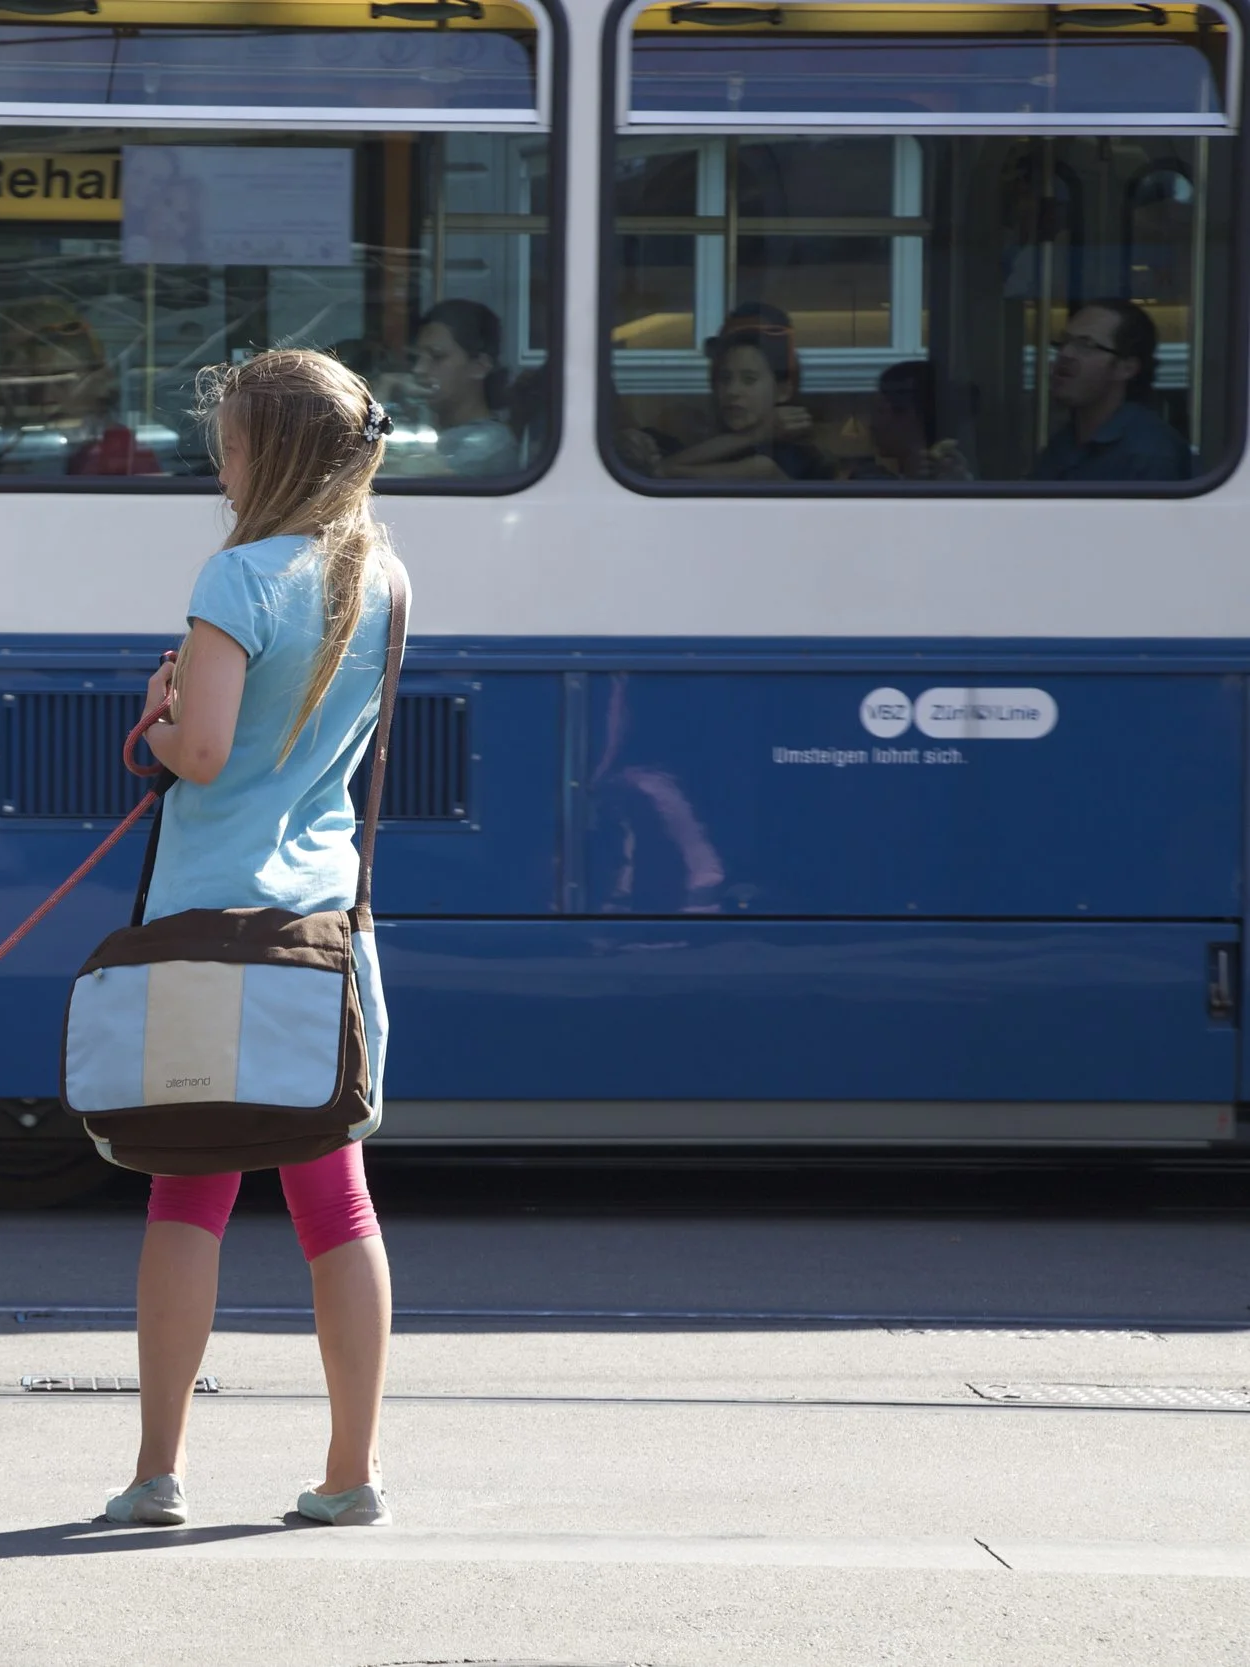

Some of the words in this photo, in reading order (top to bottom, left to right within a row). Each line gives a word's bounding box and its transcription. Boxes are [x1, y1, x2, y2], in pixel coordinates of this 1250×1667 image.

[865, 703, 906, 721] VBZ
[771, 746, 868, 767] Umsteigen
[871, 746, 919, 764] lohnt
